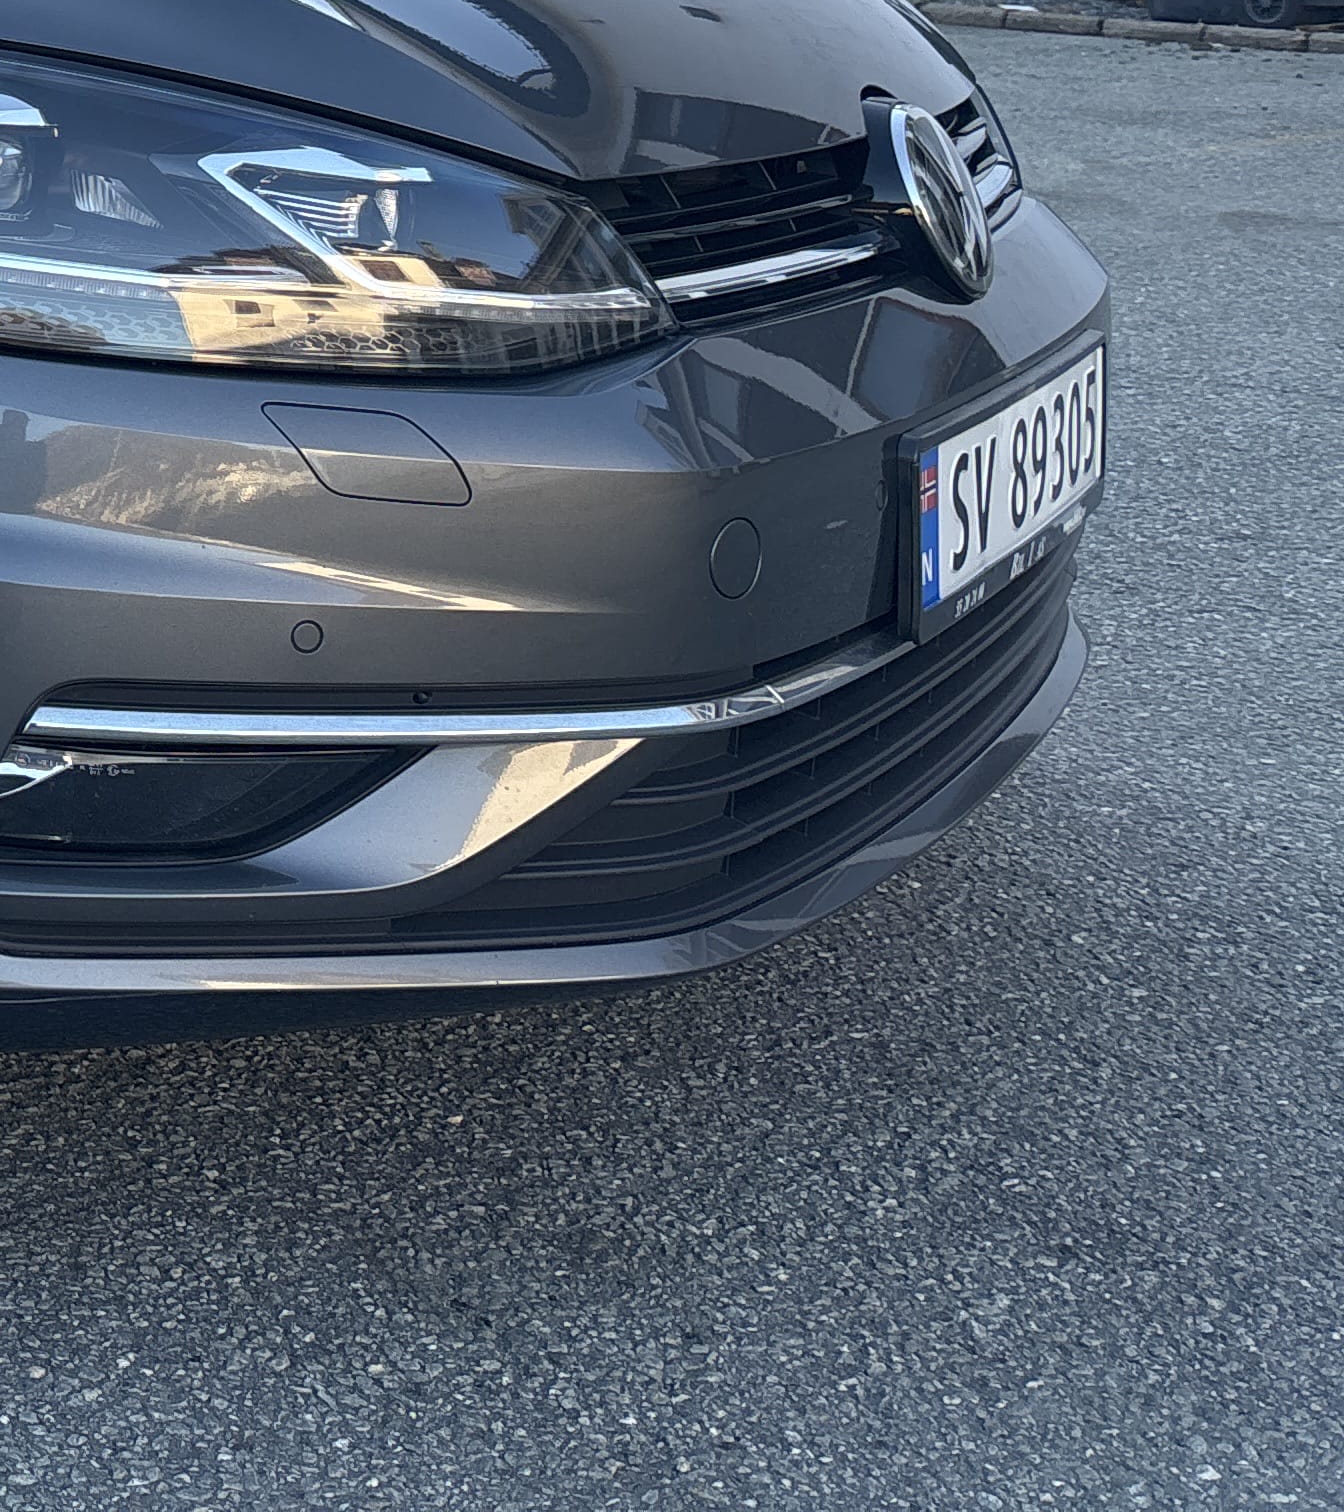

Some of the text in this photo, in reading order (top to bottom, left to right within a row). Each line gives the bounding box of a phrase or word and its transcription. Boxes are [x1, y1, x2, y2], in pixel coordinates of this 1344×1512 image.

[949, 364, 1097, 571] SV 89305
[922, 550, 933, 586] N
